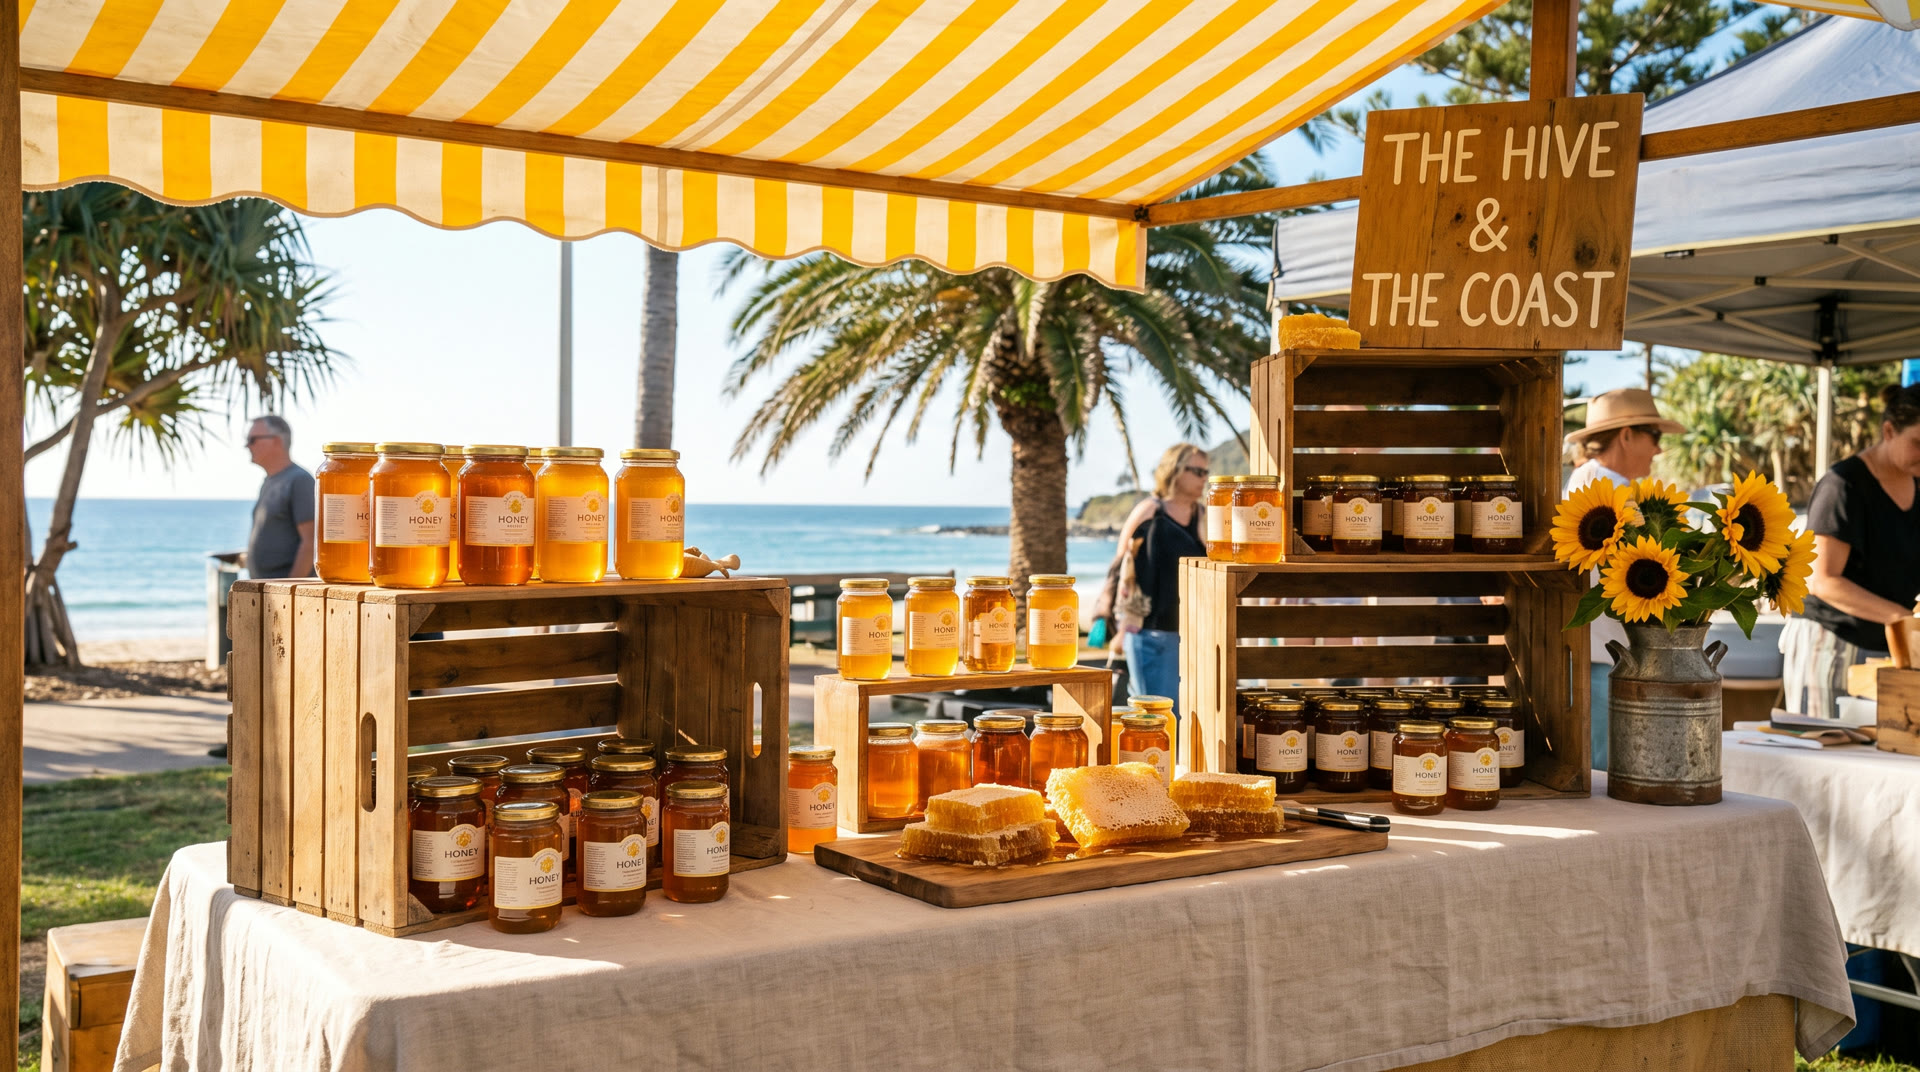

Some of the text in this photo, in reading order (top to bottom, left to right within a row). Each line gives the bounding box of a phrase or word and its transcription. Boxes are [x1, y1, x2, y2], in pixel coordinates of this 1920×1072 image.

[1383, 121, 1620, 185] THE HIVE
[1469, 197, 1509, 253] &
[1362, 271, 1616, 329] THE COAST
[409, 516, 443, 525] HONEY
[498, 515, 529, 524] HONEY
[577, 514, 606, 522] HONEY
[1415, 771, 1442, 779] HONEY
[444, 847, 479, 859] HONEY
[706, 844, 729, 855] HONE
[529, 872, 560, 885] HONEY
